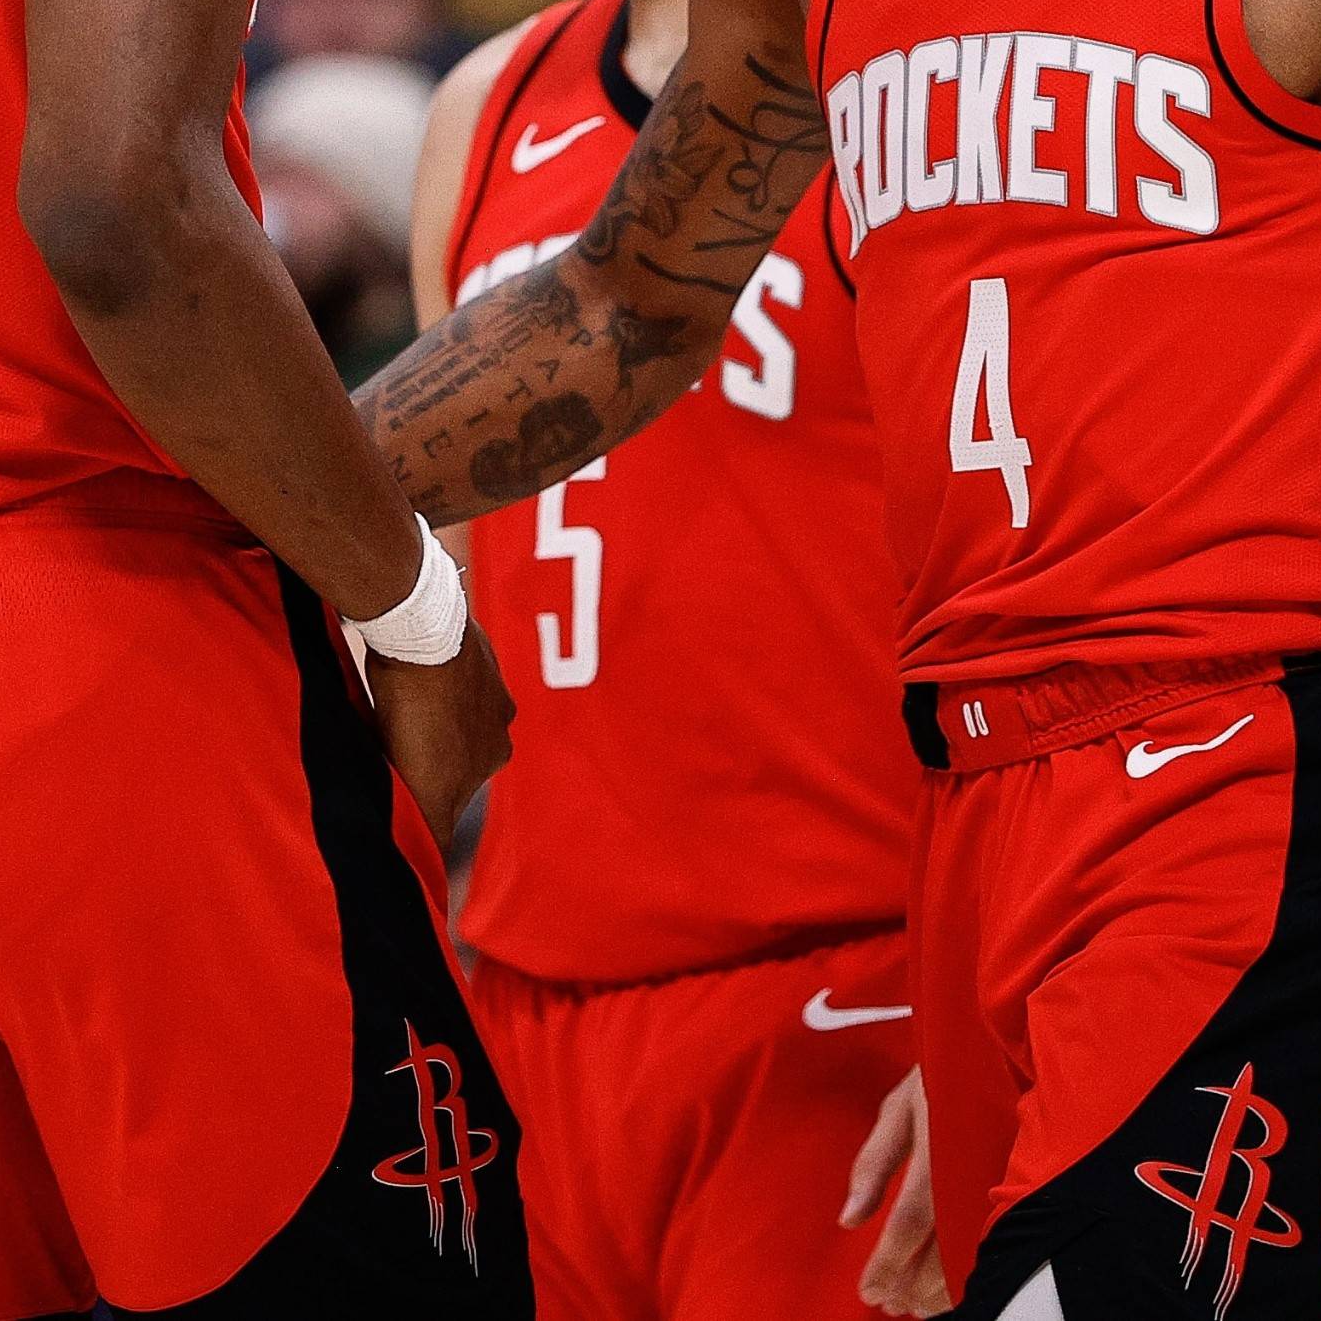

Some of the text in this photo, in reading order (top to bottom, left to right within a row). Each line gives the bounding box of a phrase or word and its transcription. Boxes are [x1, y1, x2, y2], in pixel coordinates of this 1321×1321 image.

[826, 31, 1220, 261] ROCKETS
[948, 277, 1033, 529] 4
[533, 454, 607, 690] 5
